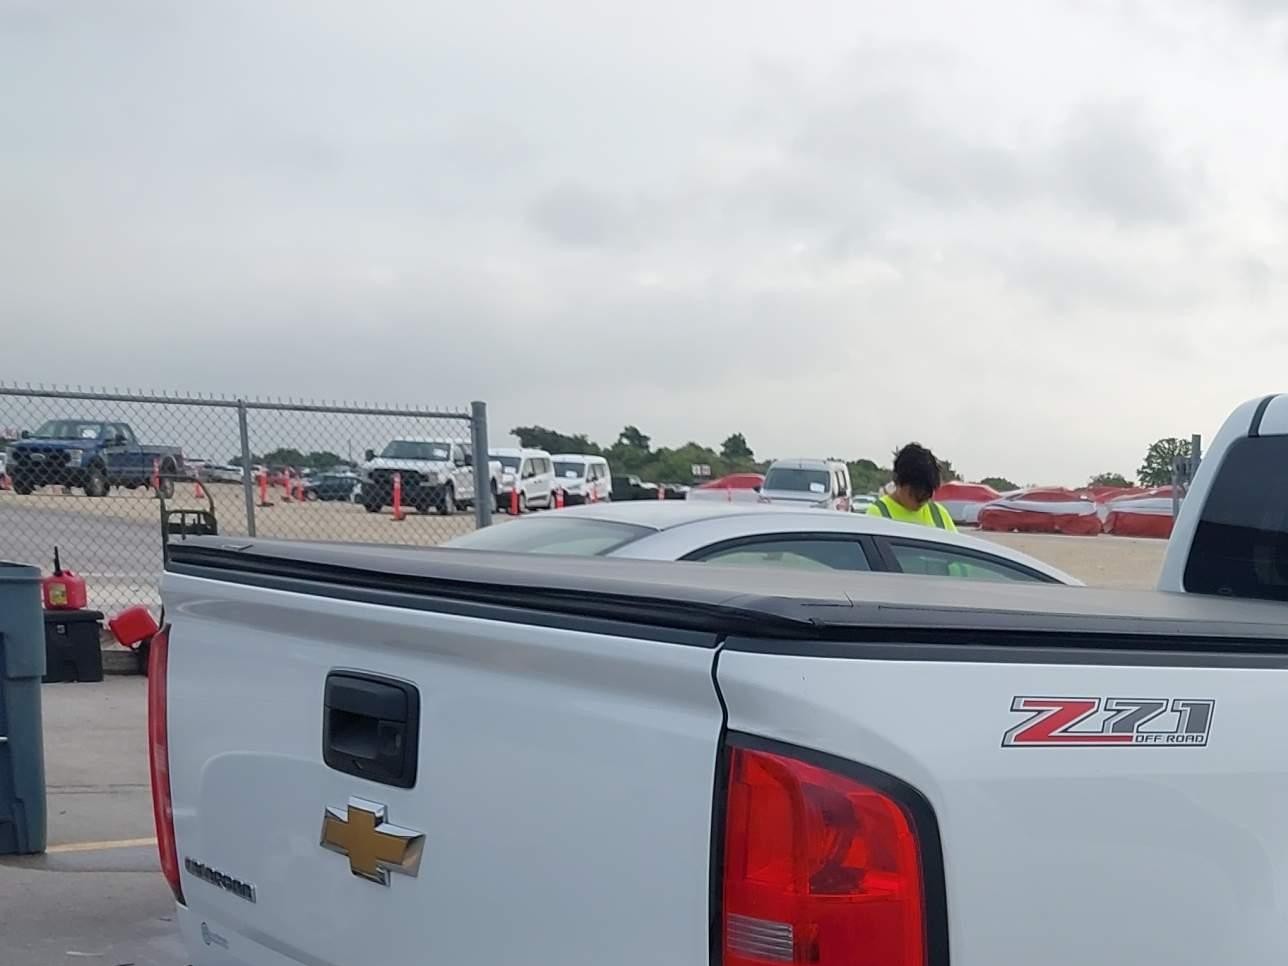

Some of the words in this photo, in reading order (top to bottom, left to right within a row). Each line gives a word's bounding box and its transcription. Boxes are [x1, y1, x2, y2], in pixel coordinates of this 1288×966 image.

[1001, 696, 1216, 747] Z71
[1135, 735, 1162, 743] OFF
[1166, 735, 1205, 743] ROAD
